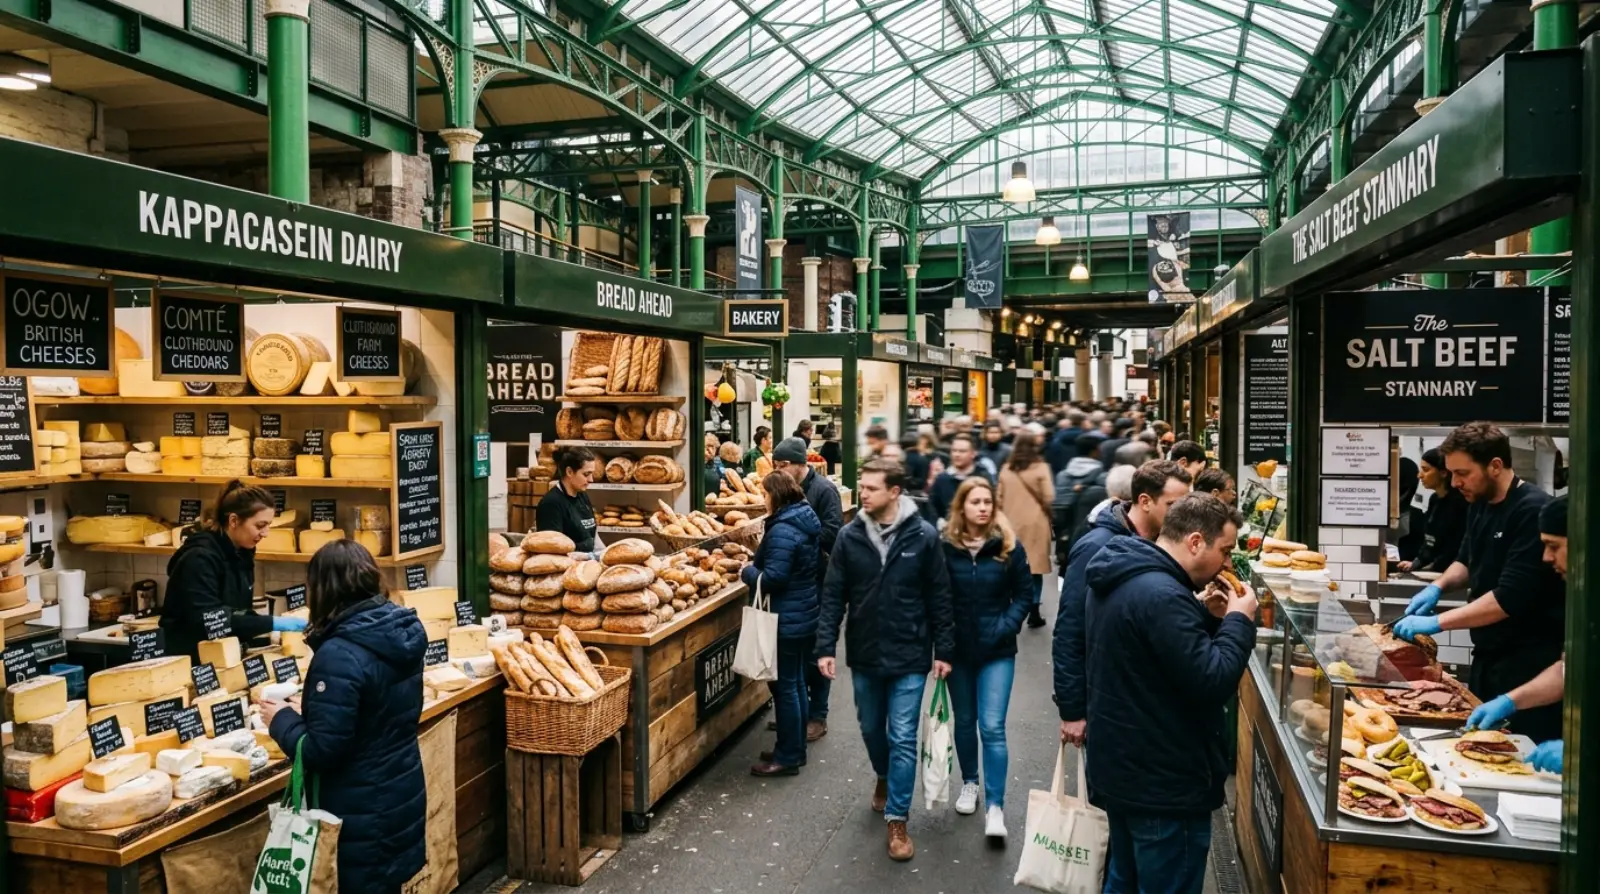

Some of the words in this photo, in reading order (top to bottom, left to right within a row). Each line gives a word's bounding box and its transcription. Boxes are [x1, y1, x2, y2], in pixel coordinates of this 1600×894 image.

[1292, 224, 1308, 264] THE
[1309, 208, 1331, 256] SALT
[1333, 187, 1360, 243] BEEF
[1363, 133, 1440, 225] STANNARY
[139, 190, 333, 262] KAPPACASEIN
[341, 230, 403, 273] DAIRY
[596, 281, 635, 312] BREAD
[638, 290, 673, 318] AHEAD
[732, 310, 780, 326] BAKERY
[1413, 314, 1448, 332] The
[24, 325, 84, 343] BRITISH
[164, 336, 233, 353] CLOTHBOUND
[1346, 338, 1425, 368] SALT
[1435, 336, 1518, 367] BEEF
[20, 345, 96, 365] CHEESES
[171, 354, 230, 370] CHEDDARS
[486, 362, 555, 381] BREAD
[487, 382, 556, 400] AHEAD
[1385, 380, 1477, 397] STANNARY
